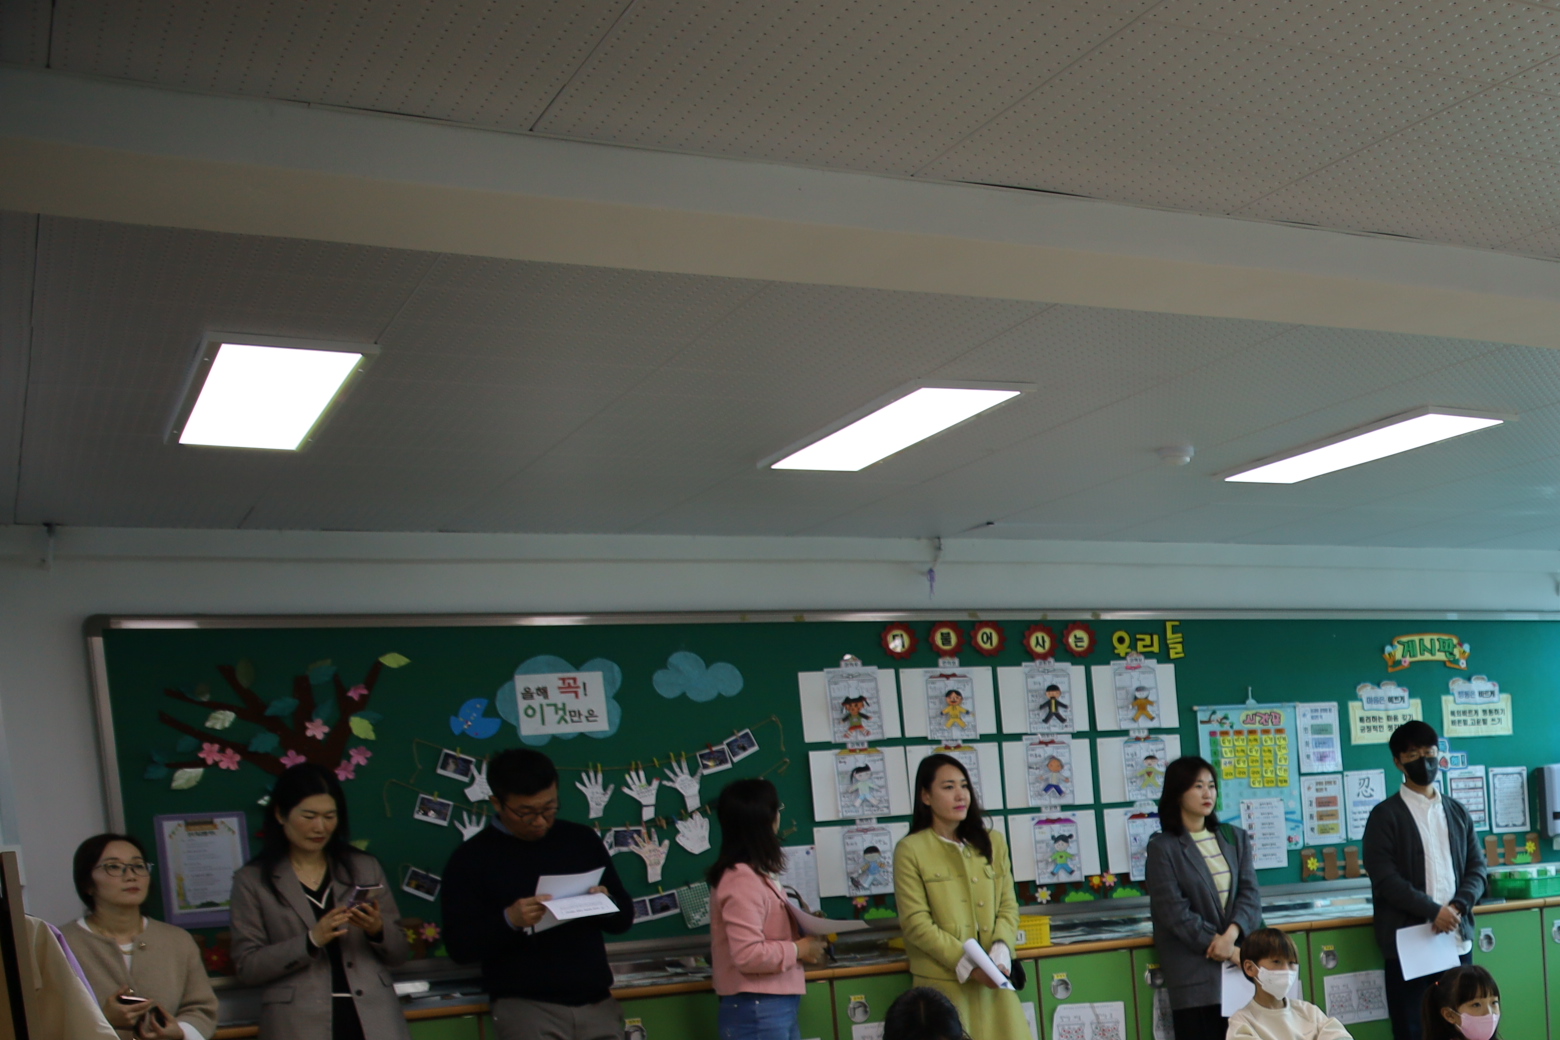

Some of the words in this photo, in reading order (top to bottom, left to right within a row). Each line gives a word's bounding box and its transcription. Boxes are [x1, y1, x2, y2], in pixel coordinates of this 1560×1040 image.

[1033, 633, 1086, 650] 사는
[1112, 621, 1185, 659] 우리들
[1397, 638, 1457, 660] 게시판
[521, 686, 549, 700] 올해
[557, 676, 587, 699] 꼭!
[523, 702, 599, 726] 이것만은
[1242, 712, 1282, 727] 시간표
[1357, 776, 1375, 799] 忍
